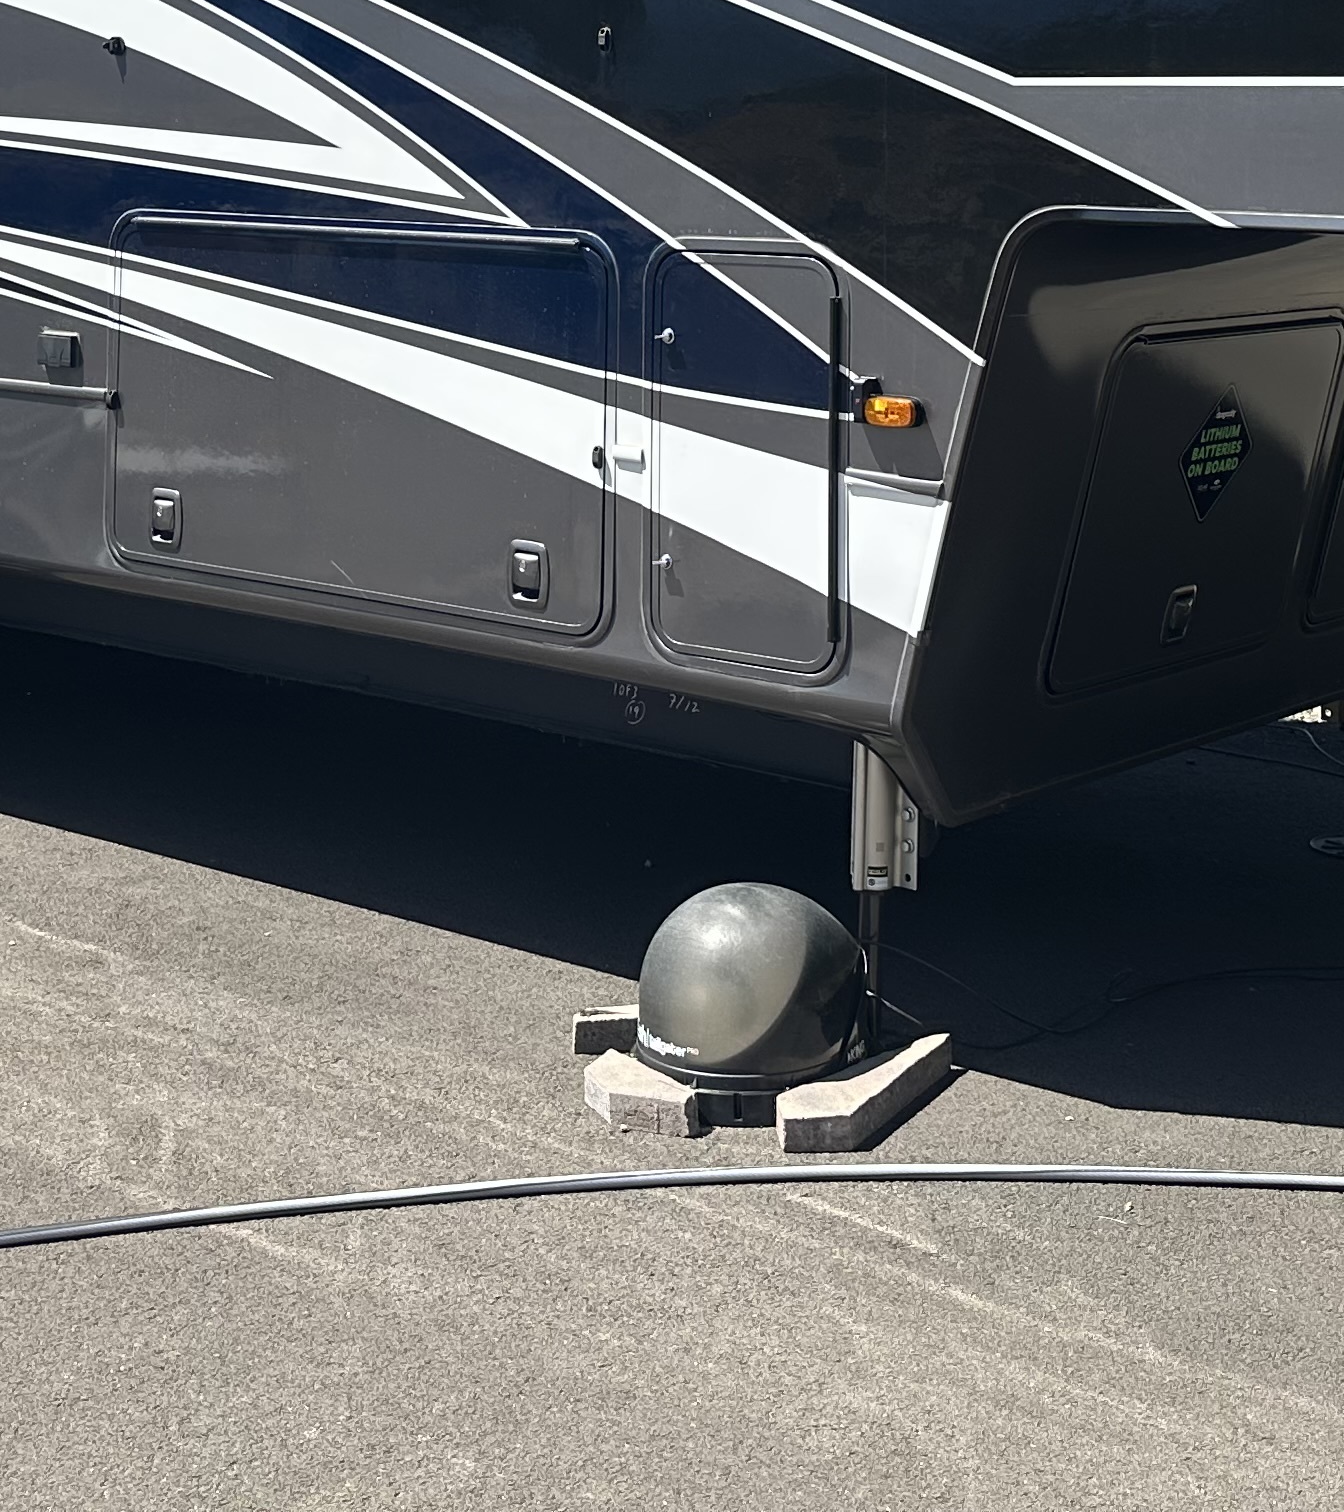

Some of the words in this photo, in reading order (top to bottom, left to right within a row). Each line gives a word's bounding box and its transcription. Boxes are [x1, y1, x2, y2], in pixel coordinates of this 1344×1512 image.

[1200, 424, 1242, 443] LITHIUM
[1191, 440, 1243, 461] BATTERIES
[1187, 462, 1204, 478] ON
[1204, 457, 1239, 475] BOARD
